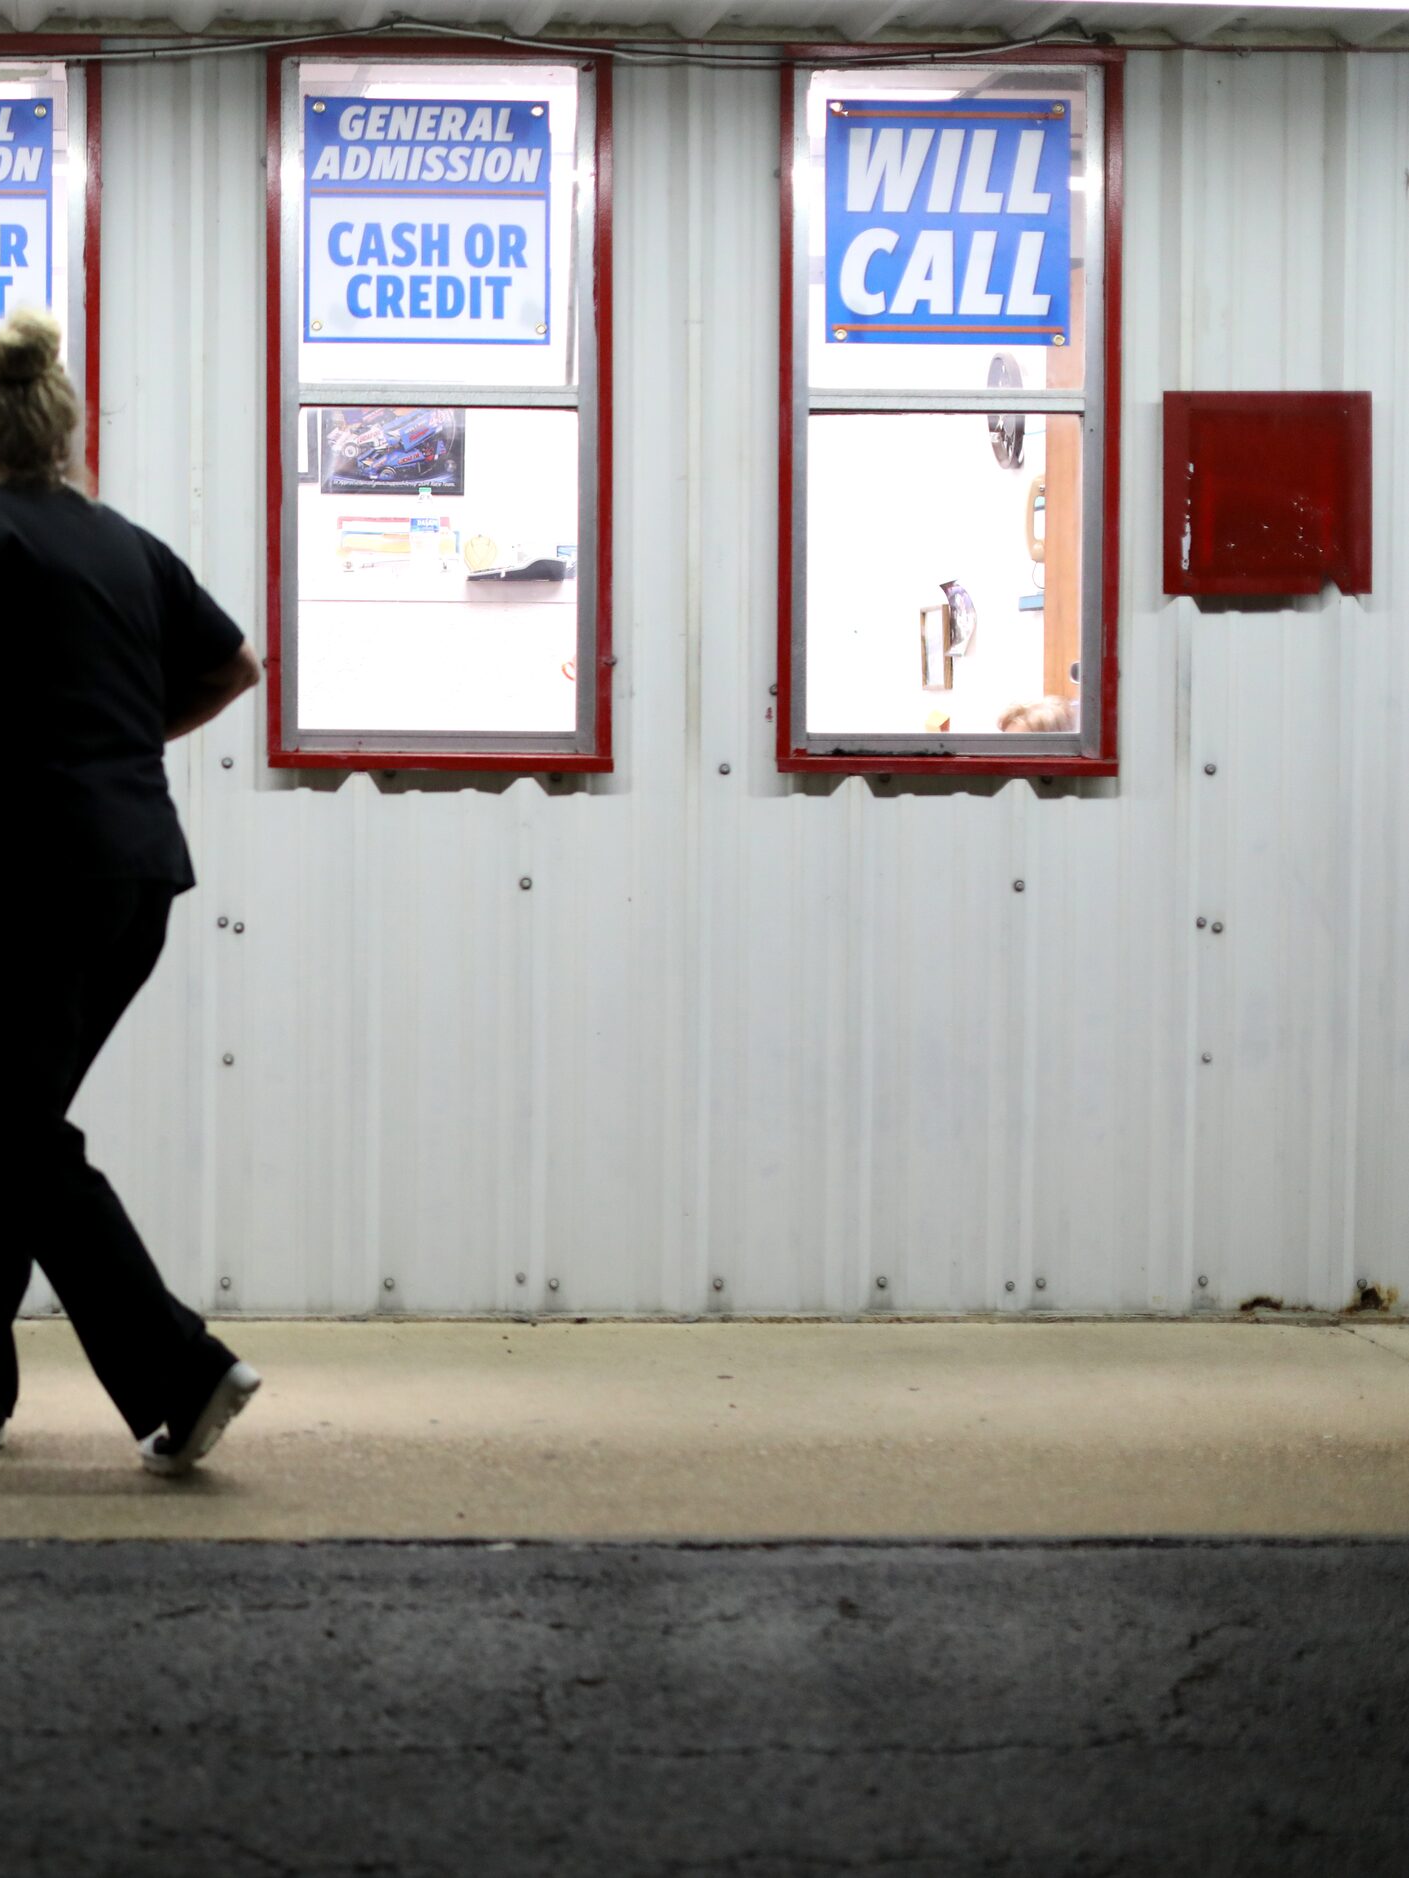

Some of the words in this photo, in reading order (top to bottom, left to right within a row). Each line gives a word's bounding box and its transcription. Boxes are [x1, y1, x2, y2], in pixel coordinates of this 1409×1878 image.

[338, 105, 515, 142] GENERAL
[310, 145, 543, 183] ADMISSION
[845, 127, 1051, 214] WILL
[327, 221, 450, 267] CASH
[464, 223, 528, 268] OR
[840, 227, 1052, 316] CALL
[346, 274, 512, 319] CREDIT
